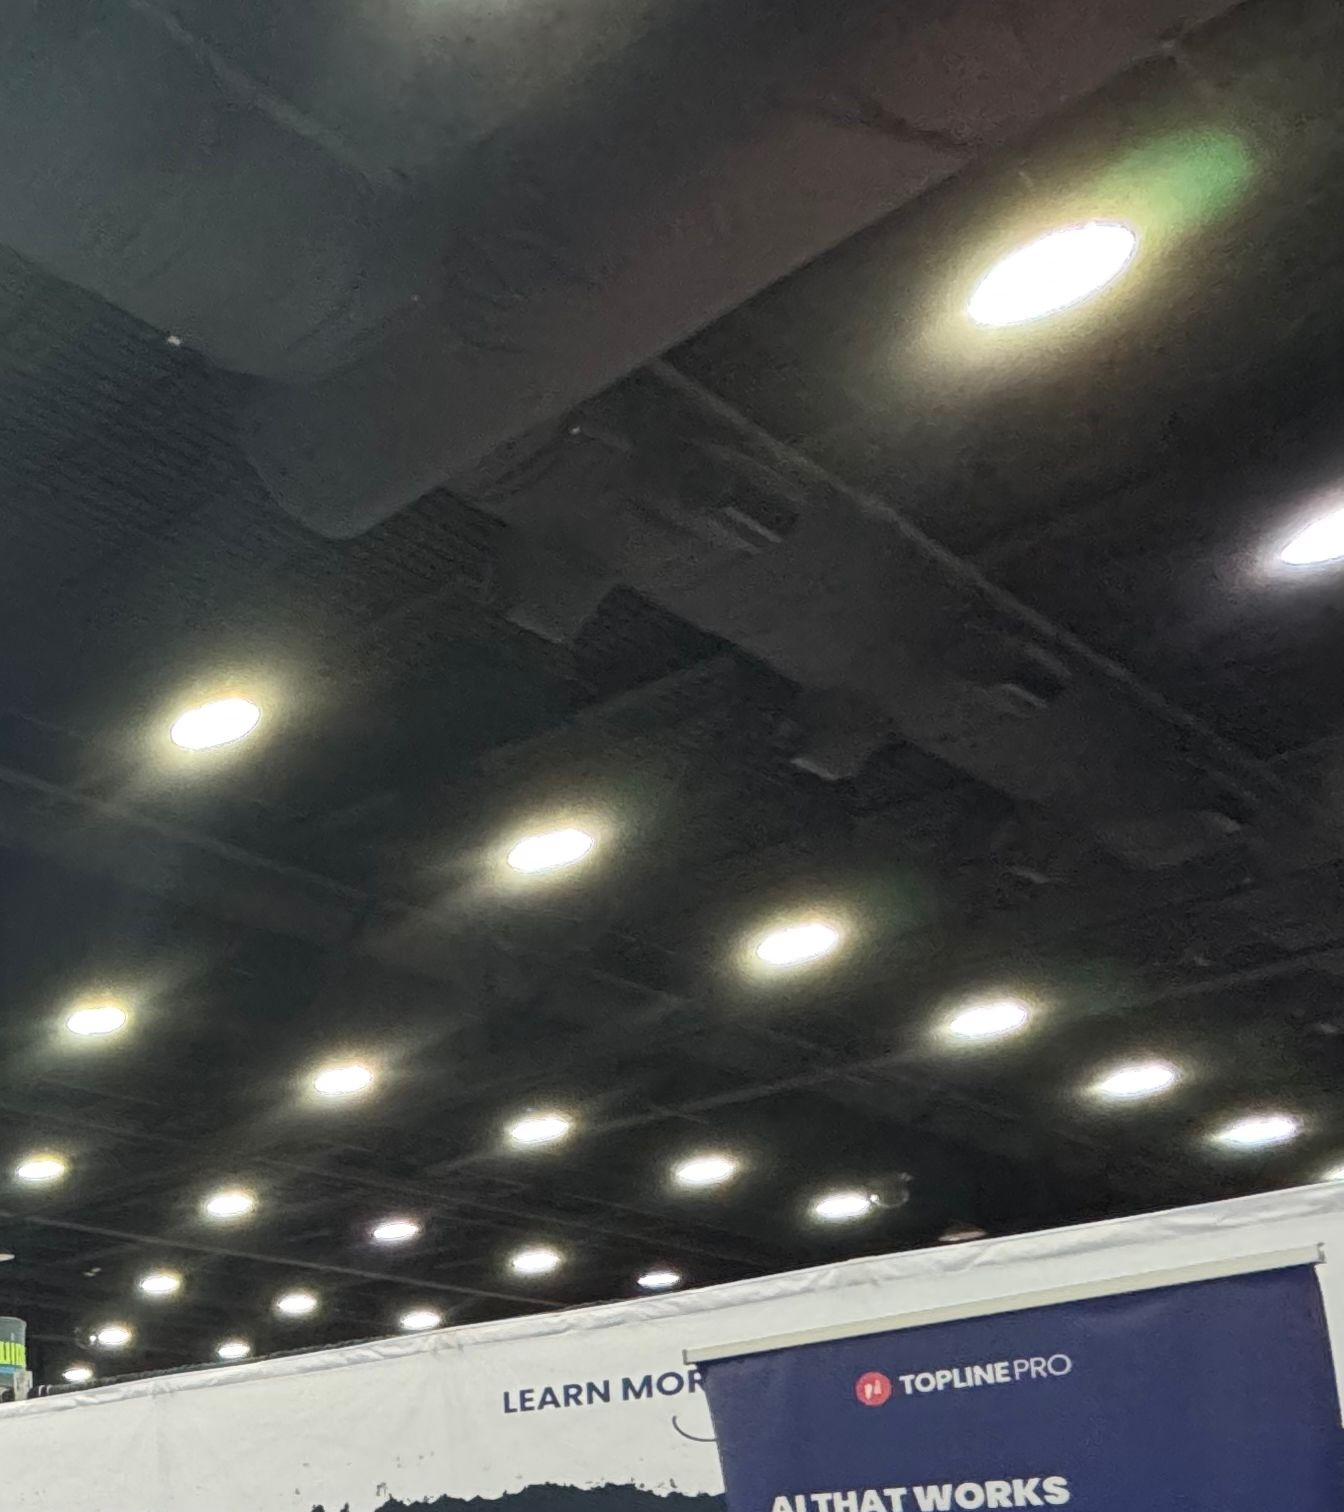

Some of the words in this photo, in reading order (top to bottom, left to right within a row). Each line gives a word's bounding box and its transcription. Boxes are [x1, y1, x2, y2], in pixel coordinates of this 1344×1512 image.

[502, 1379, 611, 1414] LEARN
[620, 1368, 707, 1402] MOR
[912, 1476, 1071, 1512] WORKS
